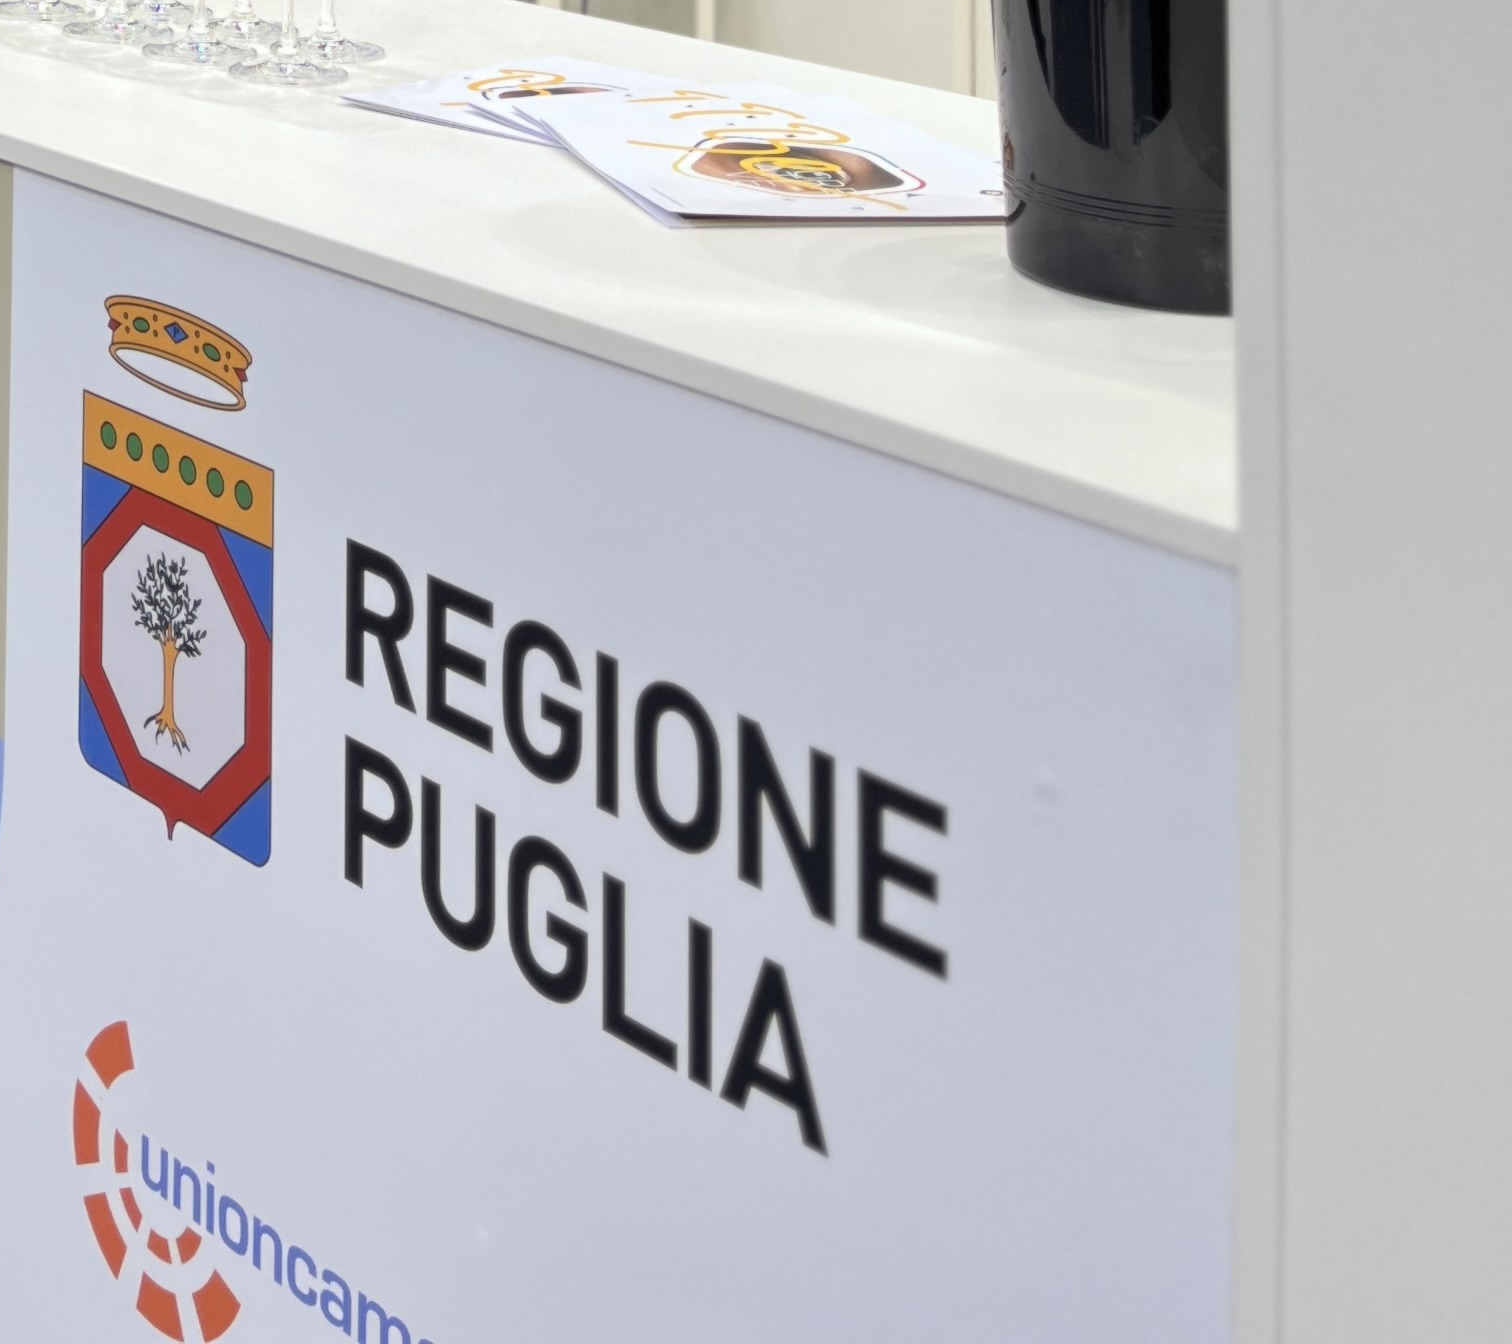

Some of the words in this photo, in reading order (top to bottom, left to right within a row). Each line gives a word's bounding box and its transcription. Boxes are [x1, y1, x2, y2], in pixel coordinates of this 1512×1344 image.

[343, 536, 950, 981] REGIONE
[343, 733, 829, 1157] PUGLIA
[141, 1133, 434, 1344] unioncam
